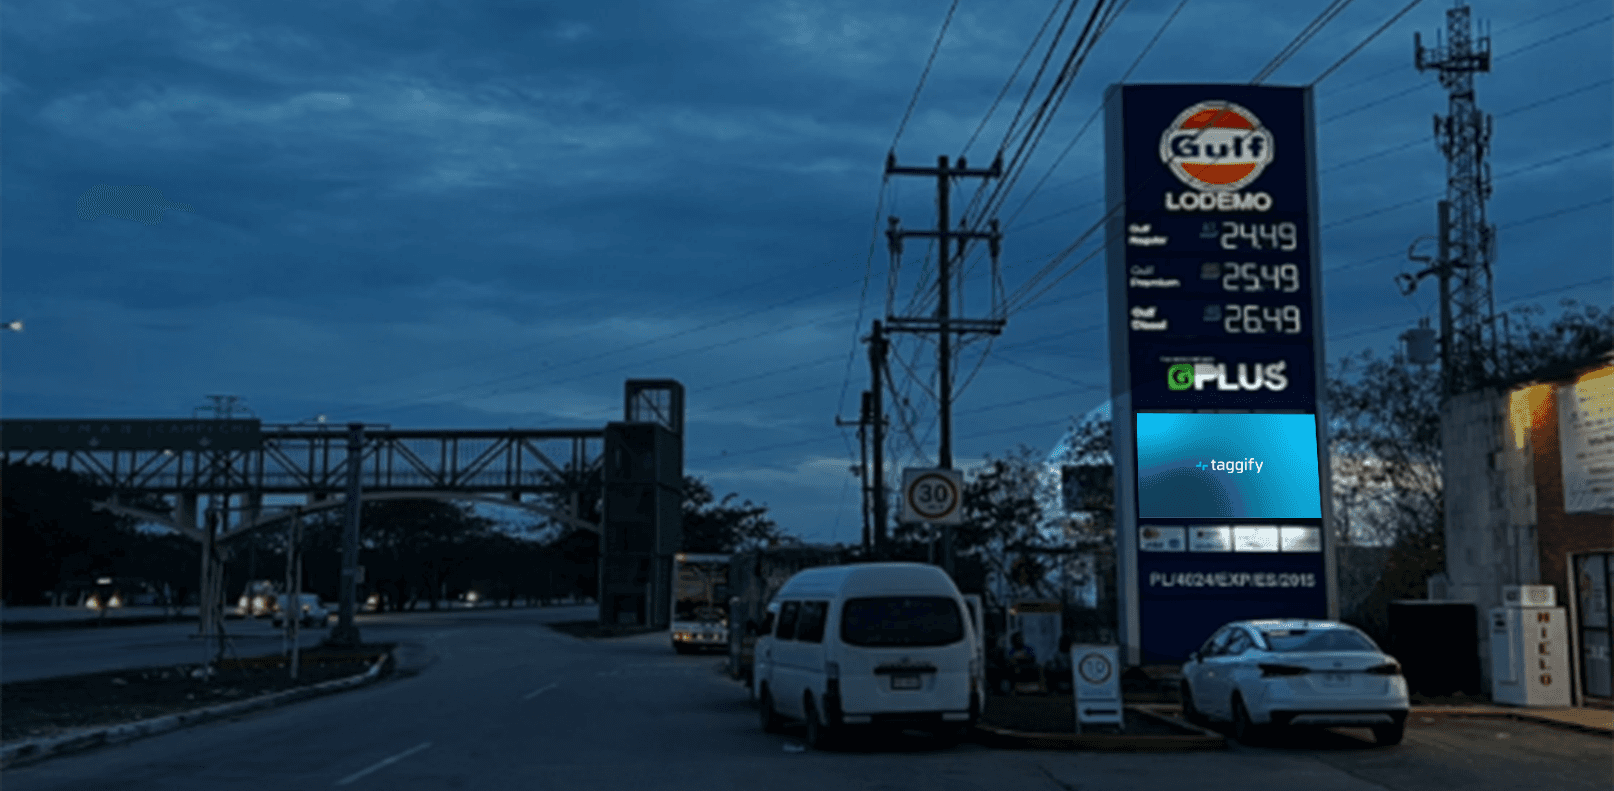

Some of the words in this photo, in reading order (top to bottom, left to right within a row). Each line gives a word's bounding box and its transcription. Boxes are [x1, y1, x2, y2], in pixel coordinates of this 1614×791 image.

[1170, 135, 1265, 158] Gulf
[1165, 191, 1273, 211] LODEMO
[1211, 457, 1264, 474] taggify
[918, 484, 948, 503] 30
[1536, 612, 1553, 687] HIELO
